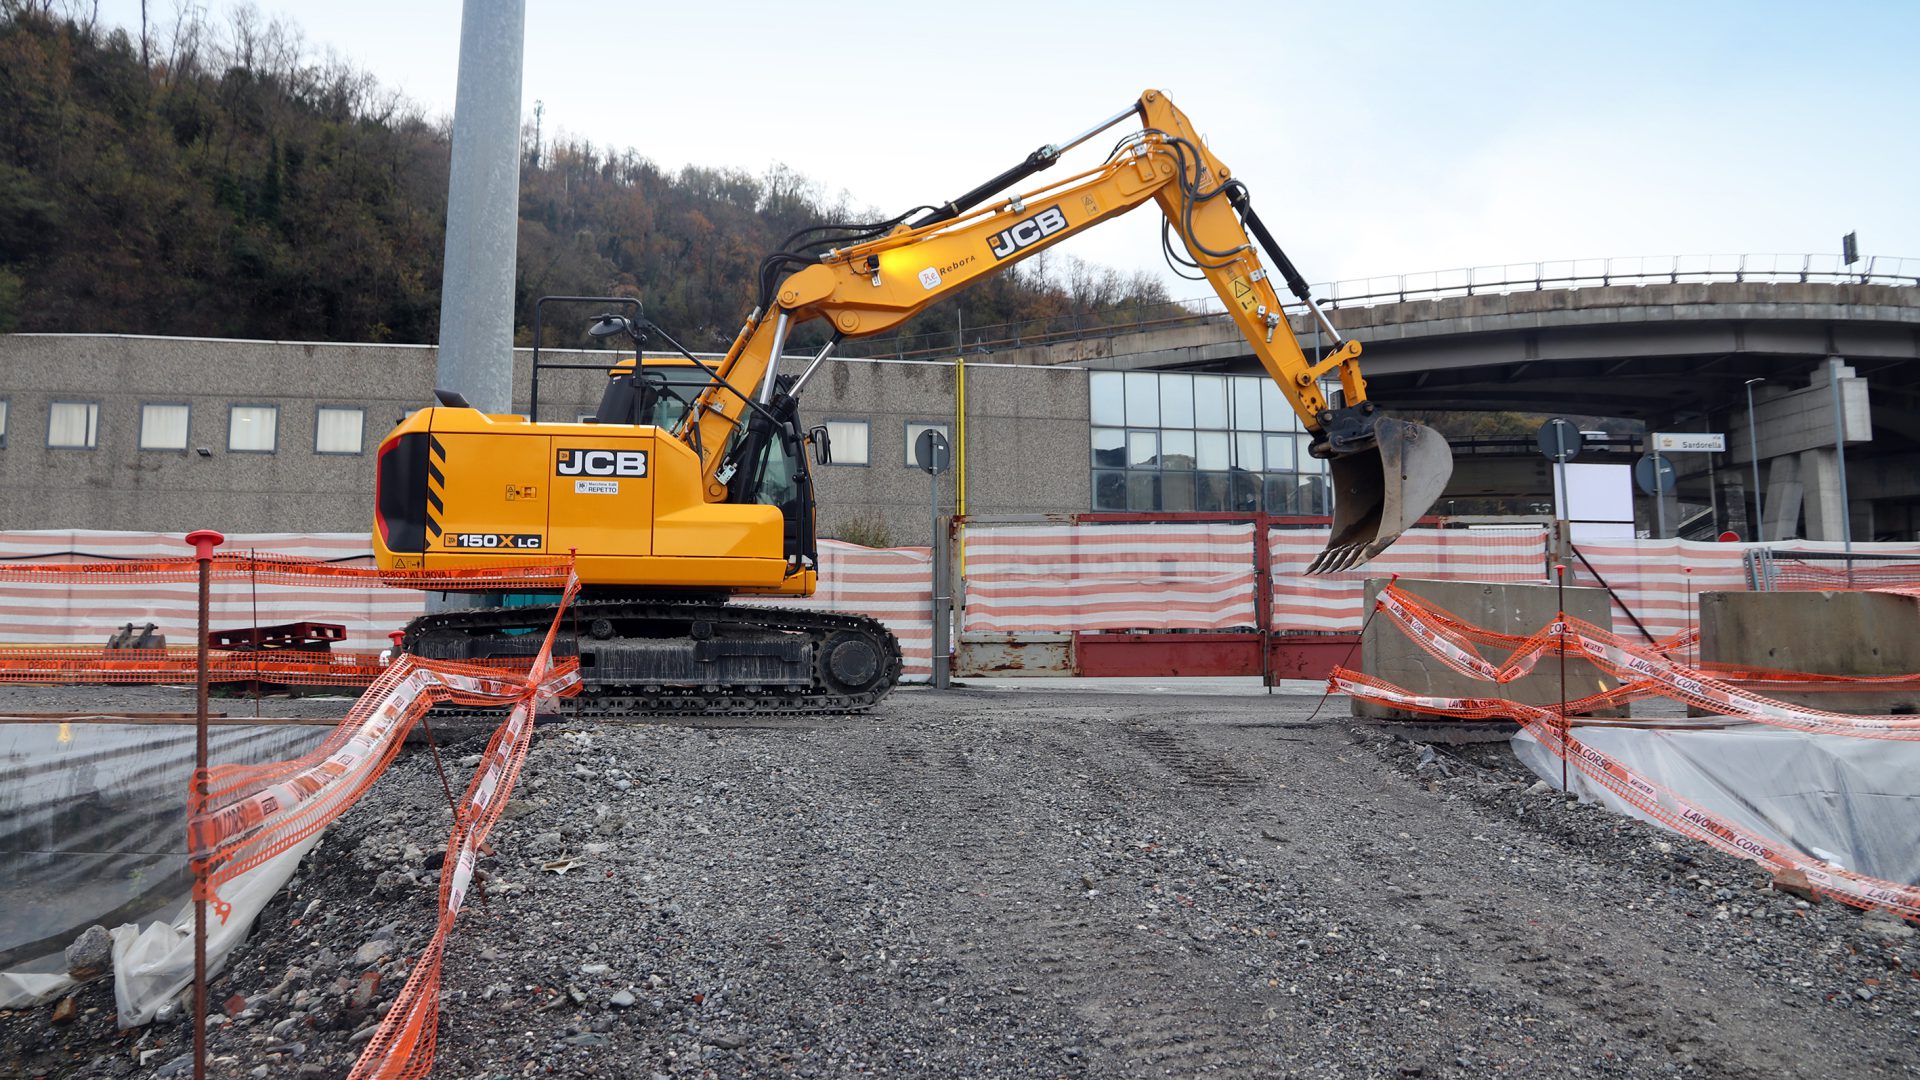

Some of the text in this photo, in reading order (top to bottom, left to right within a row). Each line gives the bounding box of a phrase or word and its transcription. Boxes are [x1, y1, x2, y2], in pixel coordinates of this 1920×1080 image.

[994, 208, 1066, 257] JCB
[558, 451, 646, 476] JCB
[517, 538, 539, 548] LC
[1629, 657, 1712, 695] LAVORI IN CORSO
[1571, 741, 1584, 754] IN
[1582, 748, 1612, 771] CORSO
[1683, 808, 1775, 860] LAVORI IN CORSO
